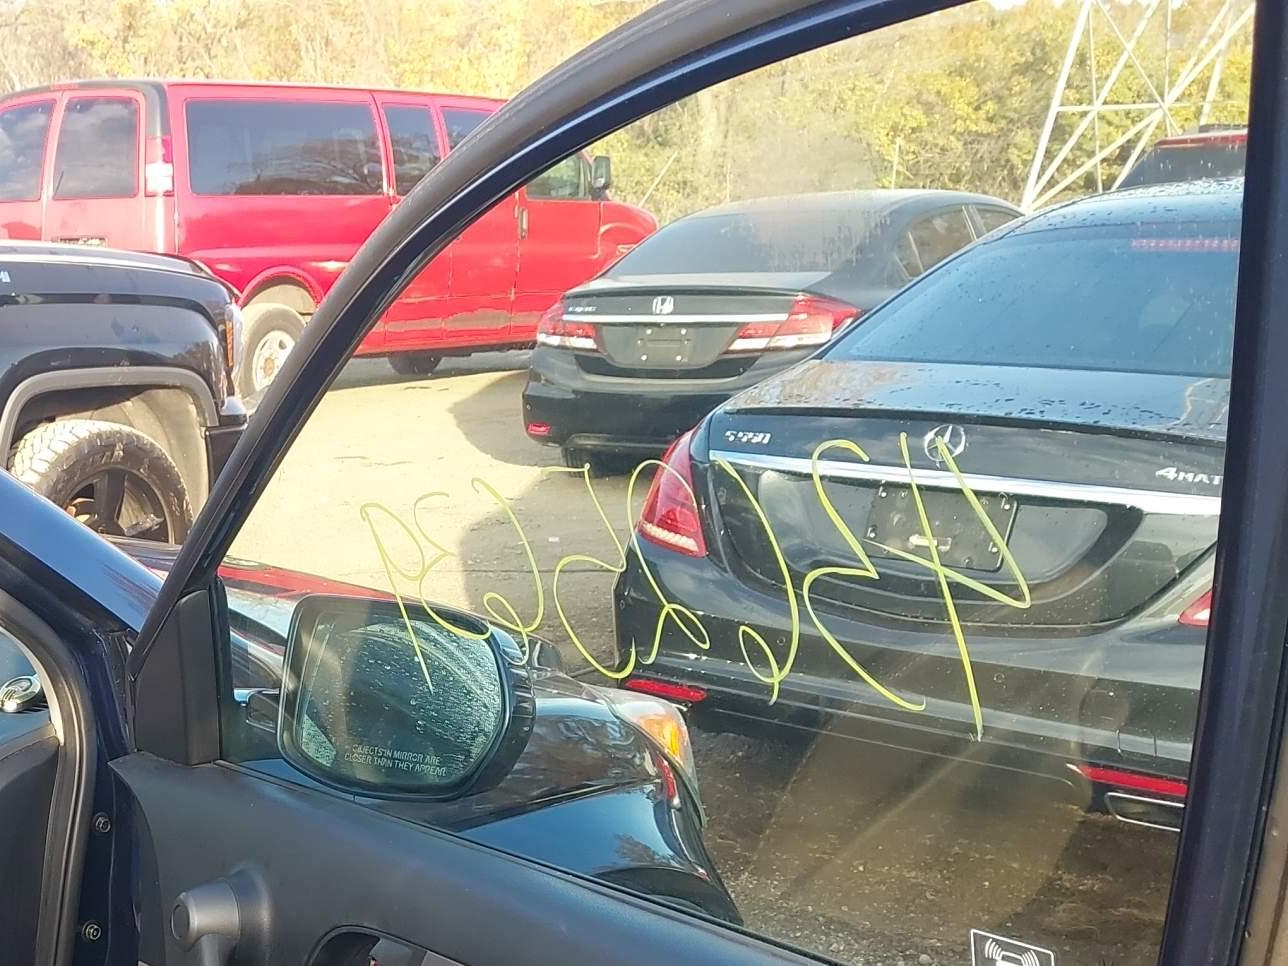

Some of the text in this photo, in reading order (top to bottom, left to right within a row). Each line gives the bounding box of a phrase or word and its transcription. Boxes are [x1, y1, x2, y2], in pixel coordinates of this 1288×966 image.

[344, 753, 447, 777] CLOSER THAN THEY APPEAR
[393, 750, 423, 763] MIRROR
[425, 754, 441, 766] ARE
